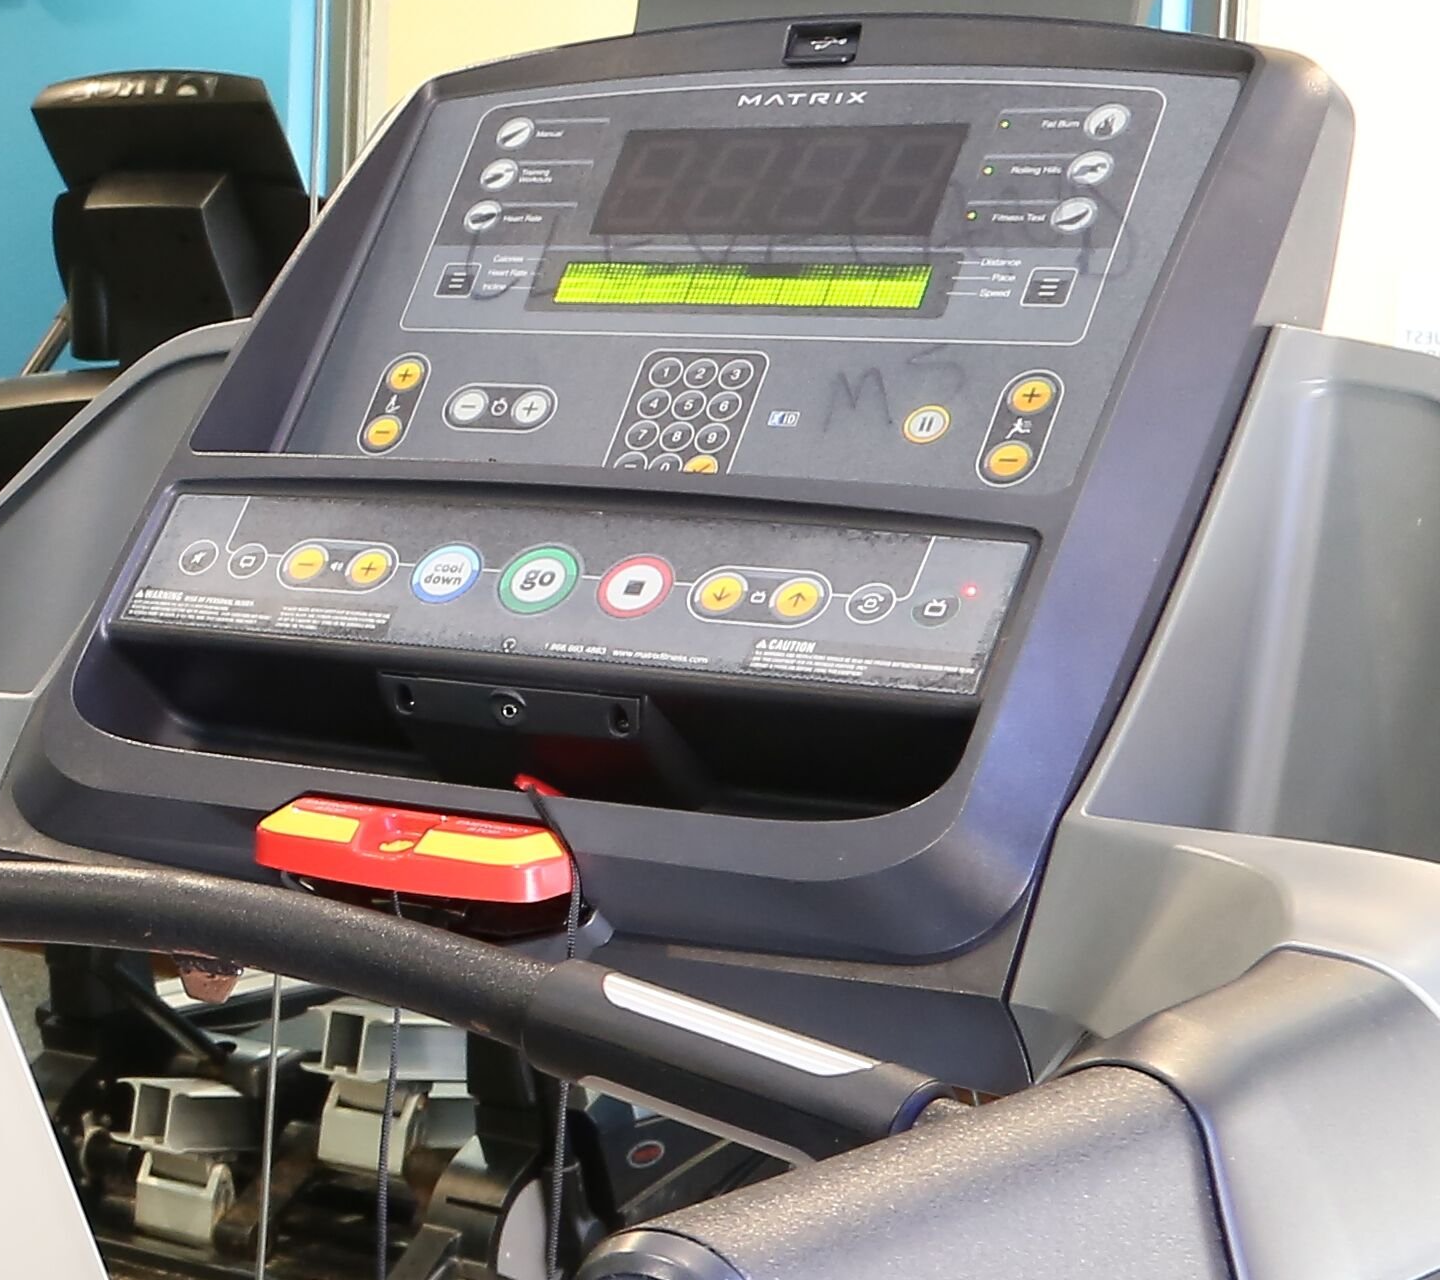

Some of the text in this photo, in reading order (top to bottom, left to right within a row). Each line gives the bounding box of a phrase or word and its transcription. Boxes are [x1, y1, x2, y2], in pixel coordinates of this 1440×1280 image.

[736, 90, 869, 108] MATRIX
[661, 366, 742, 381] 1 2 3
[648, 397, 730, 412] 4 5 6
[637, 429, 717, 444] 7 8 9
[433, 561, 464, 575] cool
[423, 573, 463, 586] down
[519, 569, 556, 592] go
[767, 638, 817, 654] CAUTION
